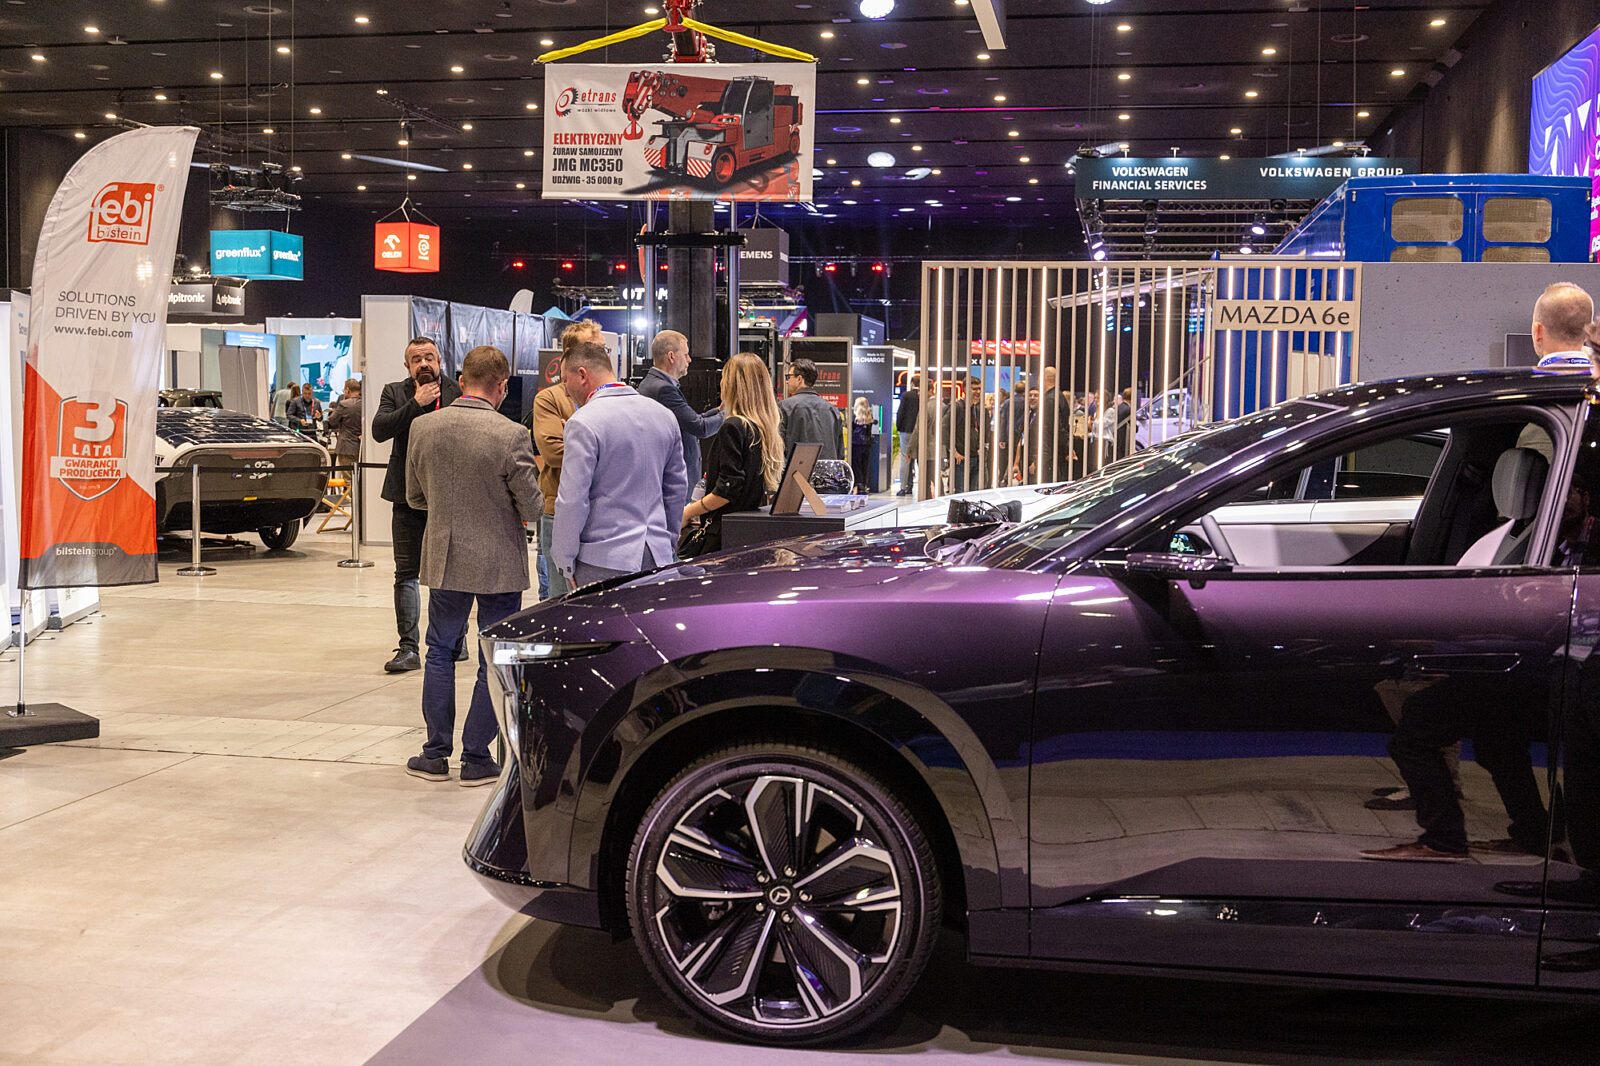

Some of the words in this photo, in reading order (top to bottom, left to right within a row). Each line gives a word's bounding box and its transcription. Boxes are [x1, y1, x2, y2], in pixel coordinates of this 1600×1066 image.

[581, 88, 617, 103] etrans
[553, 132, 624, 146] ELEKTRYCZNY
[552, 146, 578, 156] ŻURAW
[579, 147, 624, 156] SAMOJEZDNY
[552, 158, 577, 172] JMG
[580, 158, 624, 172] MC350
[1112, 166, 1189, 177] VOLKSWAGEN
[1259, 167, 1351, 177] VOLKSWAGEN
[1357, 167, 1404, 177] GROUP
[586, 175, 596, 185] 35
[597, 175, 613, 185] 000
[613, 176, 624, 186] kg
[1092, 180, 1152, 190] FINANCIAL
[1154, 180, 1207, 190] SERVICES
[90, 184, 153, 242] febi
[215, 247, 261, 260] greenflux
[740, 251, 774, 260] EMENS
[58, 290, 136, 307] SOLUTIONS
[55, 306, 107, 321] DRIVEN
[111, 311, 130, 323] BY
[132, 312, 156, 324] YOU
[1220, 305, 1317, 325] MAZDA
[1322, 306, 1350, 325] 6e
[54, 325, 133, 339] www.febi.com
[819, 369, 841, 381] trans
[74, 391, 117, 442] 3
[72, 443, 112, 457] LATA
[65, 459, 118, 470] GWARANCJI
[60, 468, 121, 478] PRODUCENTA
[55, 546, 115, 557] bilsteingroup
